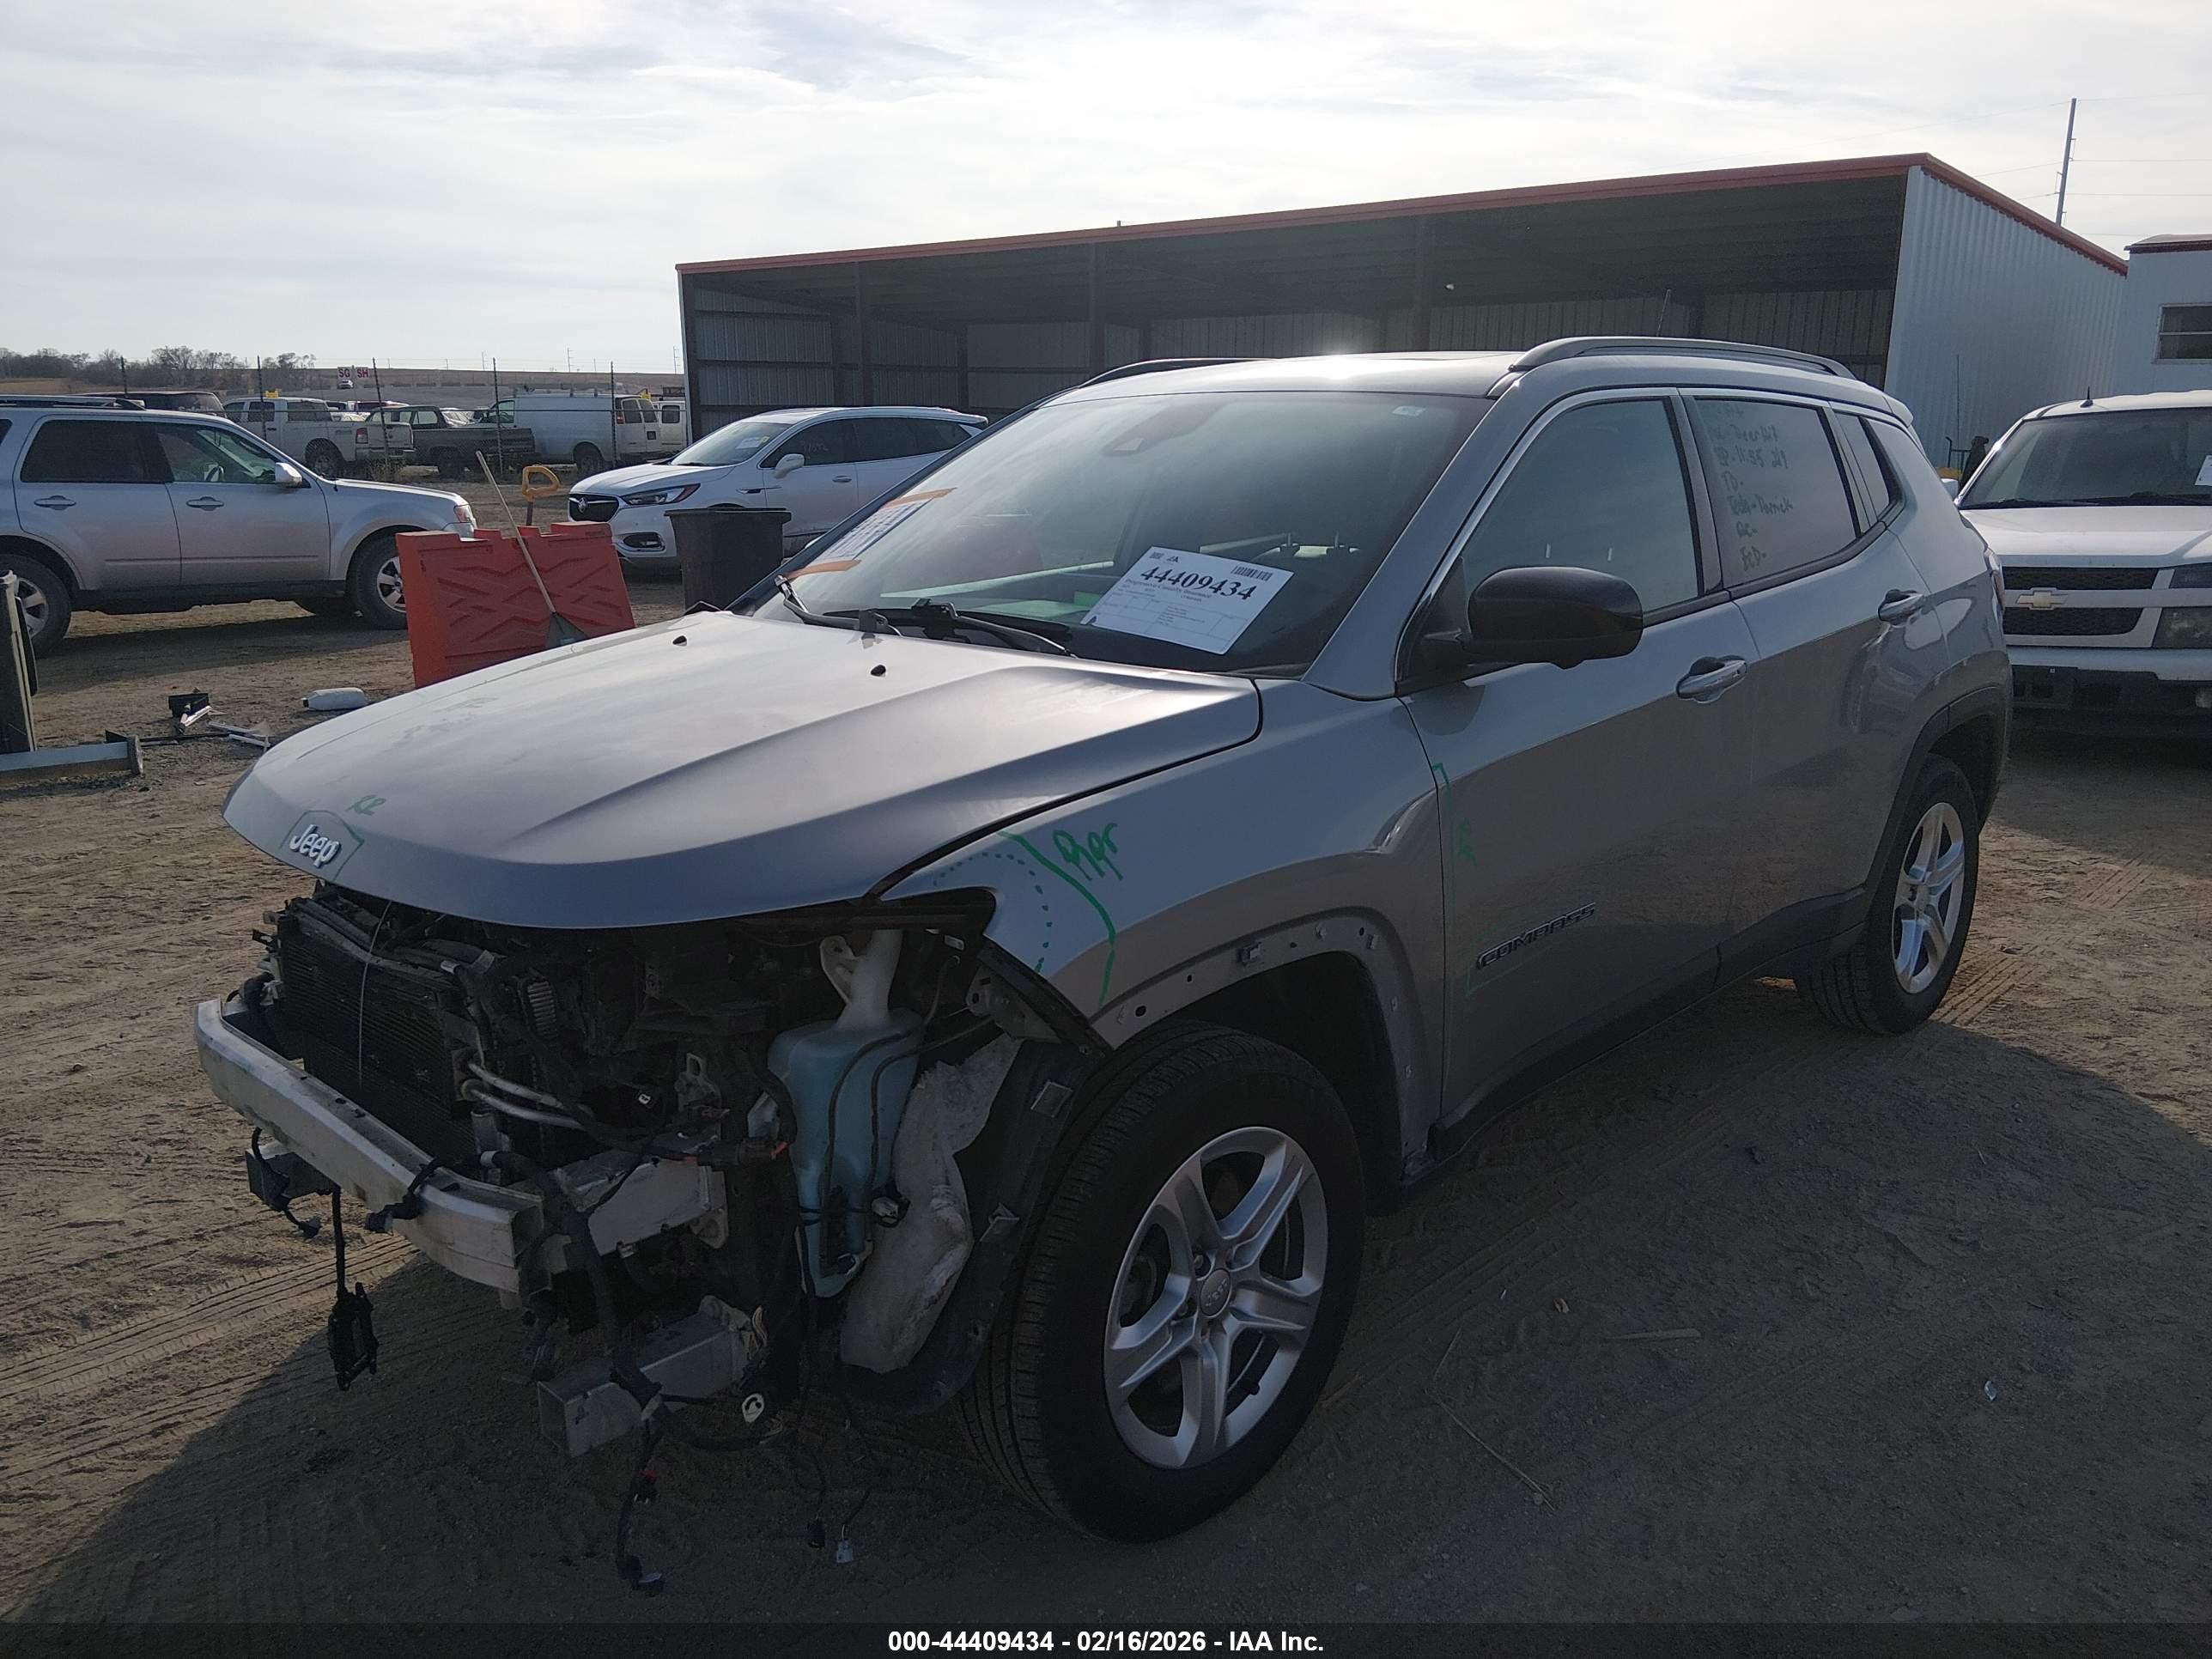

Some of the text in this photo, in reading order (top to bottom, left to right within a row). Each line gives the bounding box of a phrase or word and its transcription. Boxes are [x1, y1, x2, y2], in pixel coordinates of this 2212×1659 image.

[338, 368, 350, 378] SG
[357, 368, 369, 378] SH
[1140, 565, 1257, 600] 44409434
[289, 823, 342, 869] Jeep
[1476, 902, 1596, 969] COMPASS
